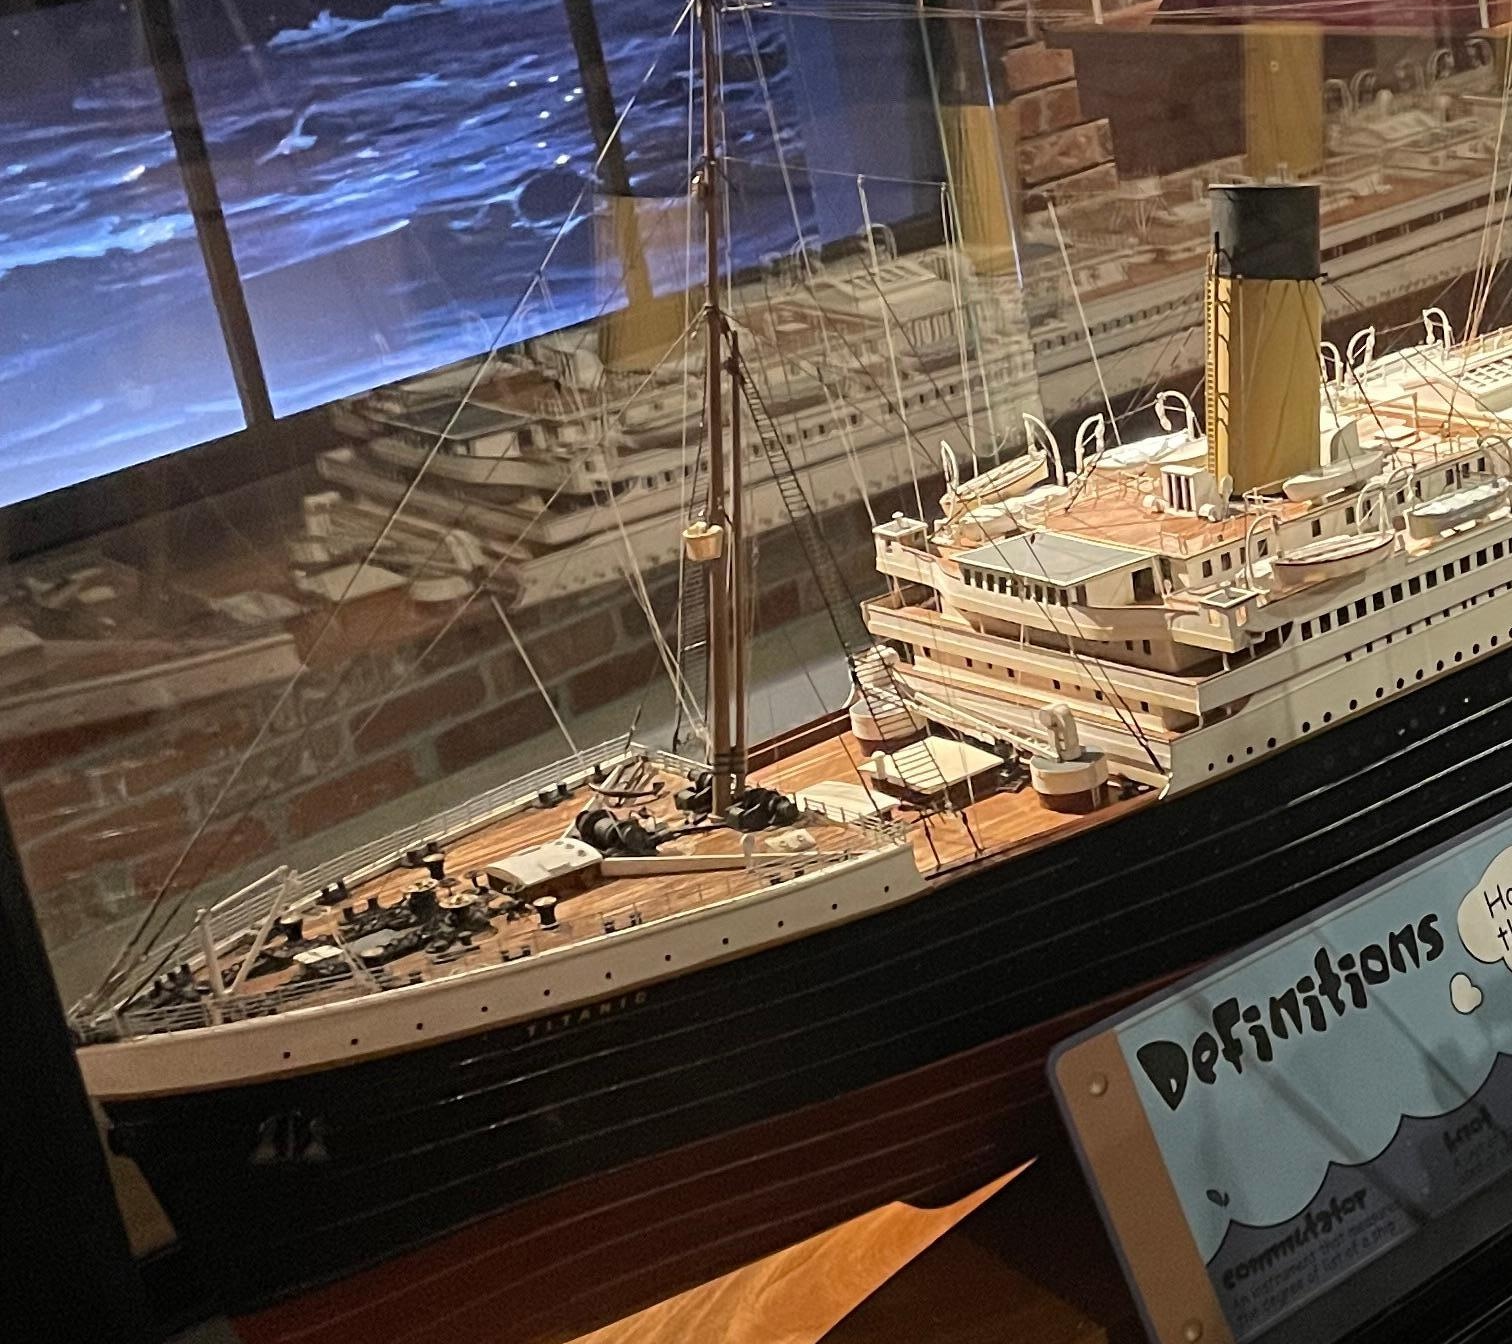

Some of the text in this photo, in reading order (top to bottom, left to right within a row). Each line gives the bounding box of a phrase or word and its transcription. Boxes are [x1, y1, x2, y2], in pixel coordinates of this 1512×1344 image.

[526, 991, 647, 1037] TITANIC
[1136, 912, 1445, 1112] Definitions
[1222, 1187, 1368, 1291] commutator
